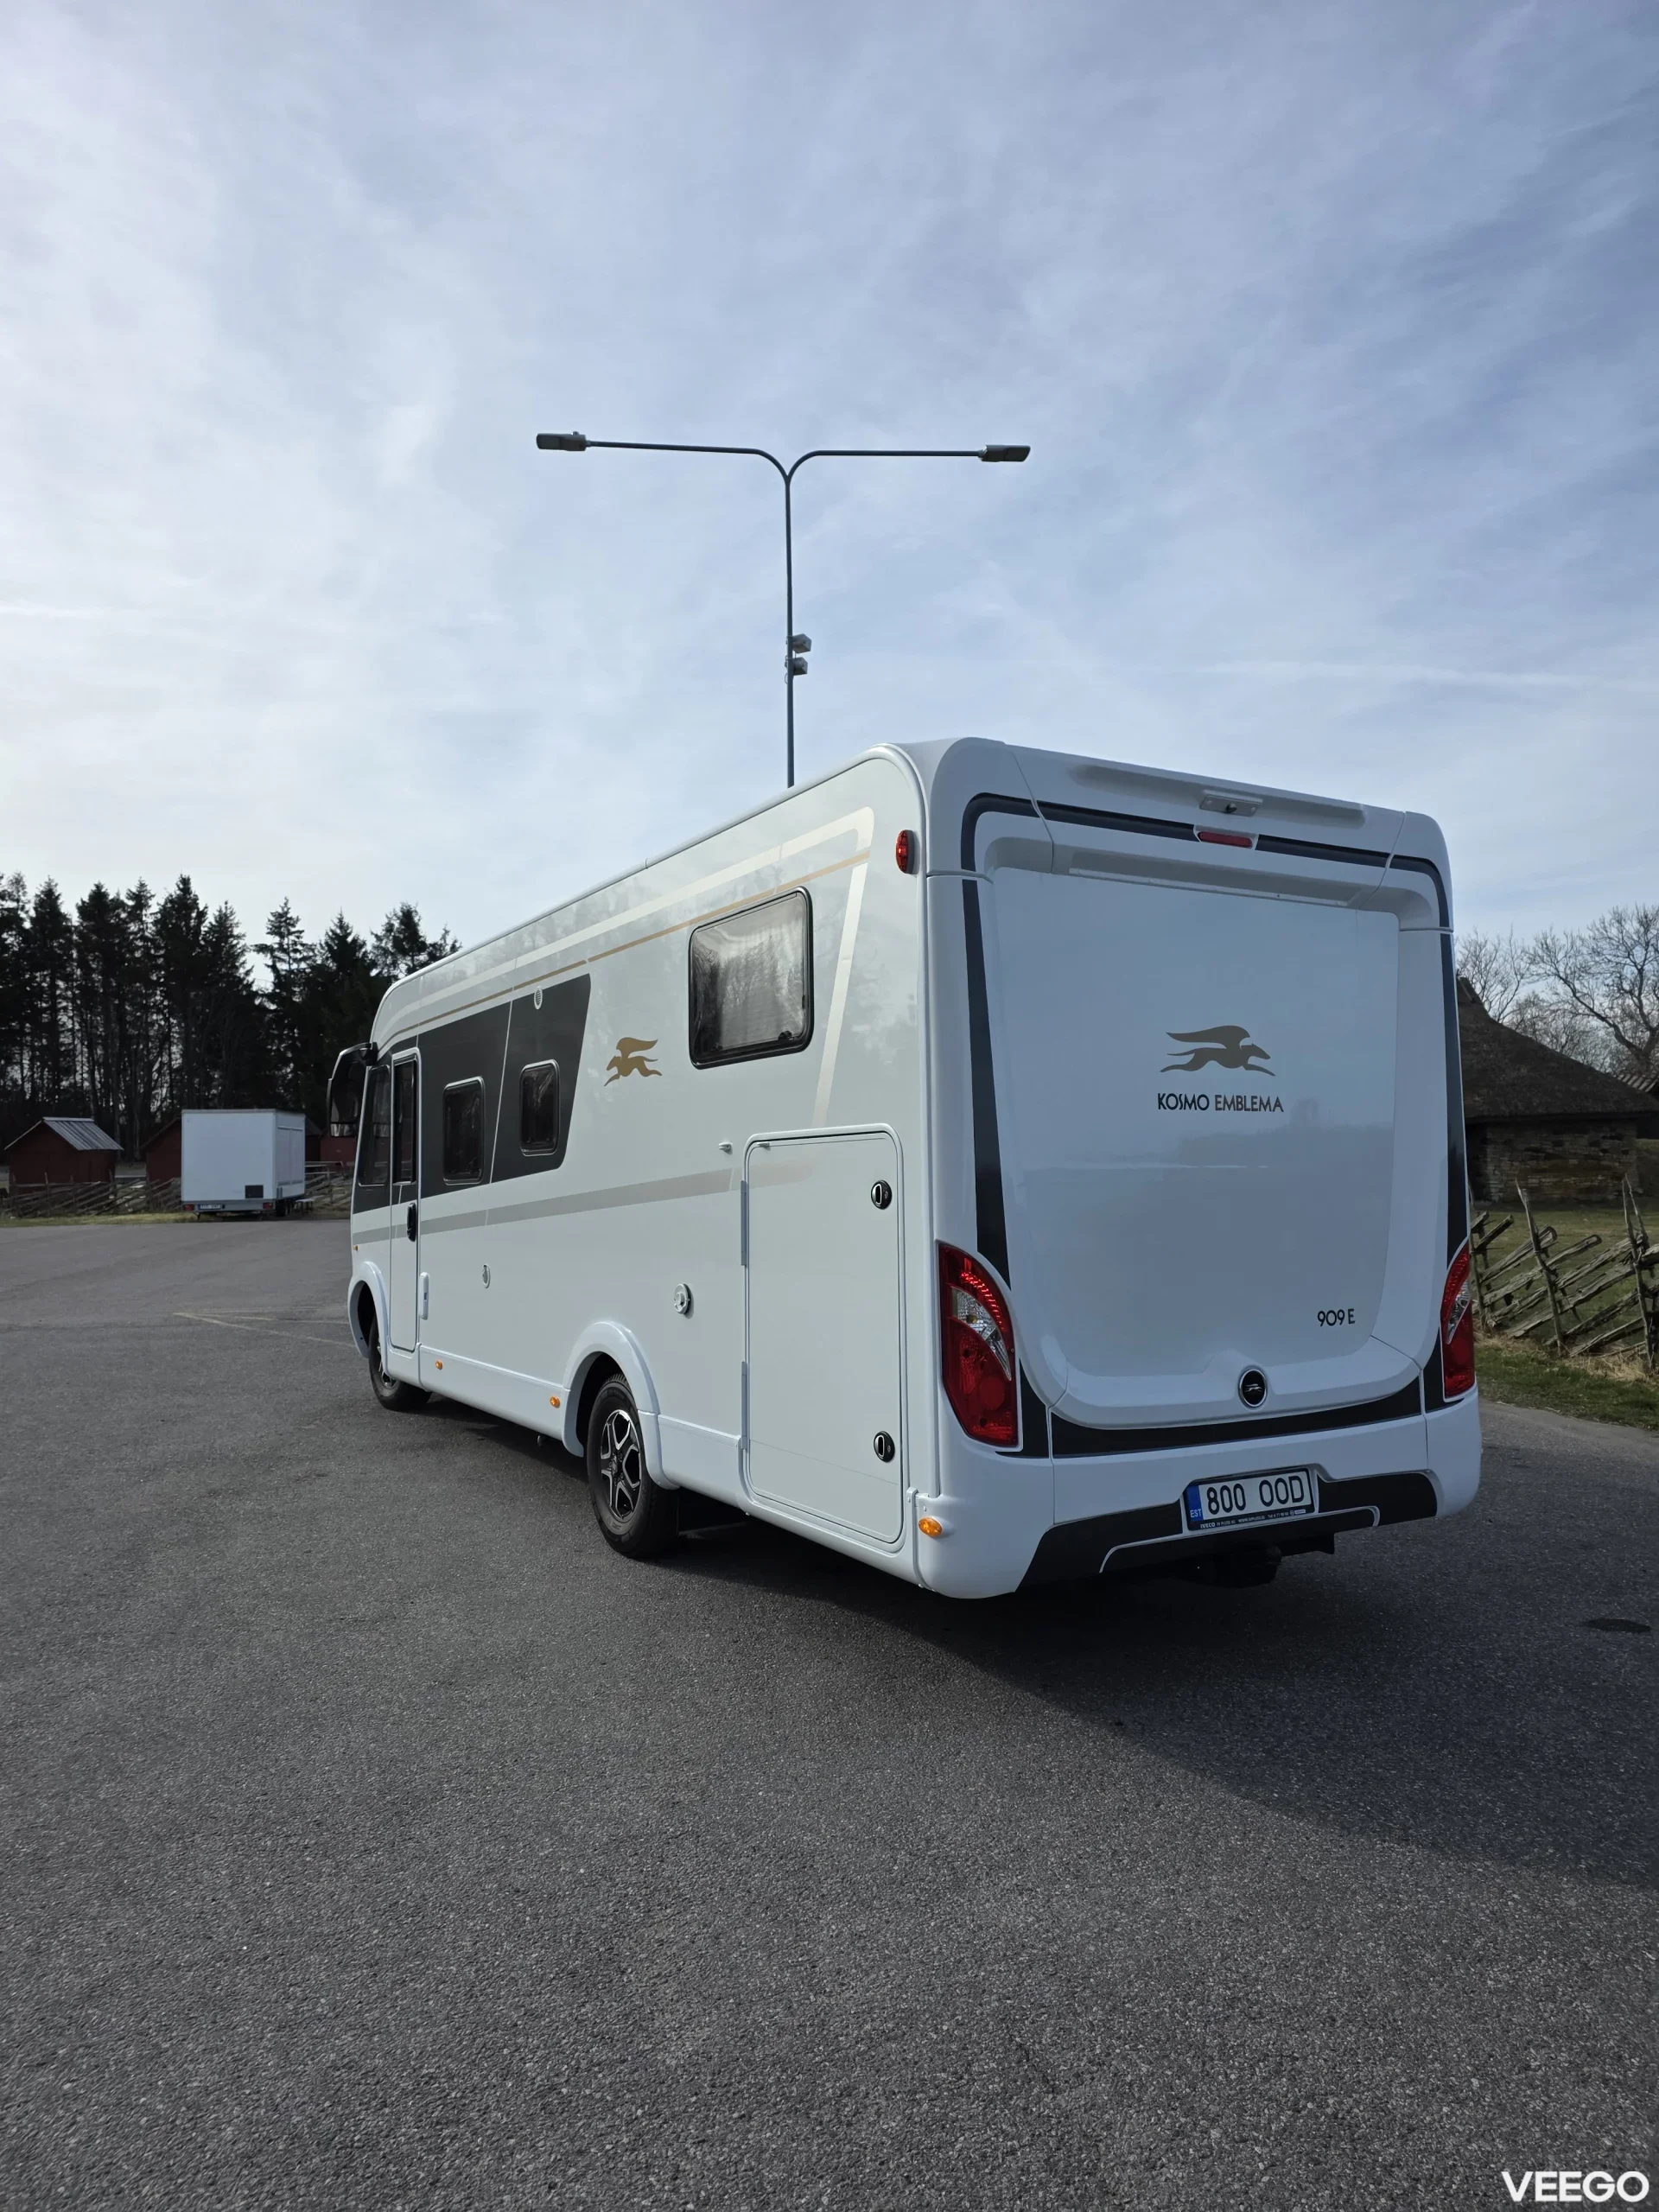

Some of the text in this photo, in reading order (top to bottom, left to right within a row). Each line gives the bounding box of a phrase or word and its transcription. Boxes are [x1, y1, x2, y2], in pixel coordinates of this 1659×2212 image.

[1157, 1092, 1285, 1113] KOSMO EMBLEMA
[1317, 1308, 1356, 1327] 909 E
[1206, 1475, 1305, 1516] 800 OOD
[1190, 1508, 1202, 1518] EST
